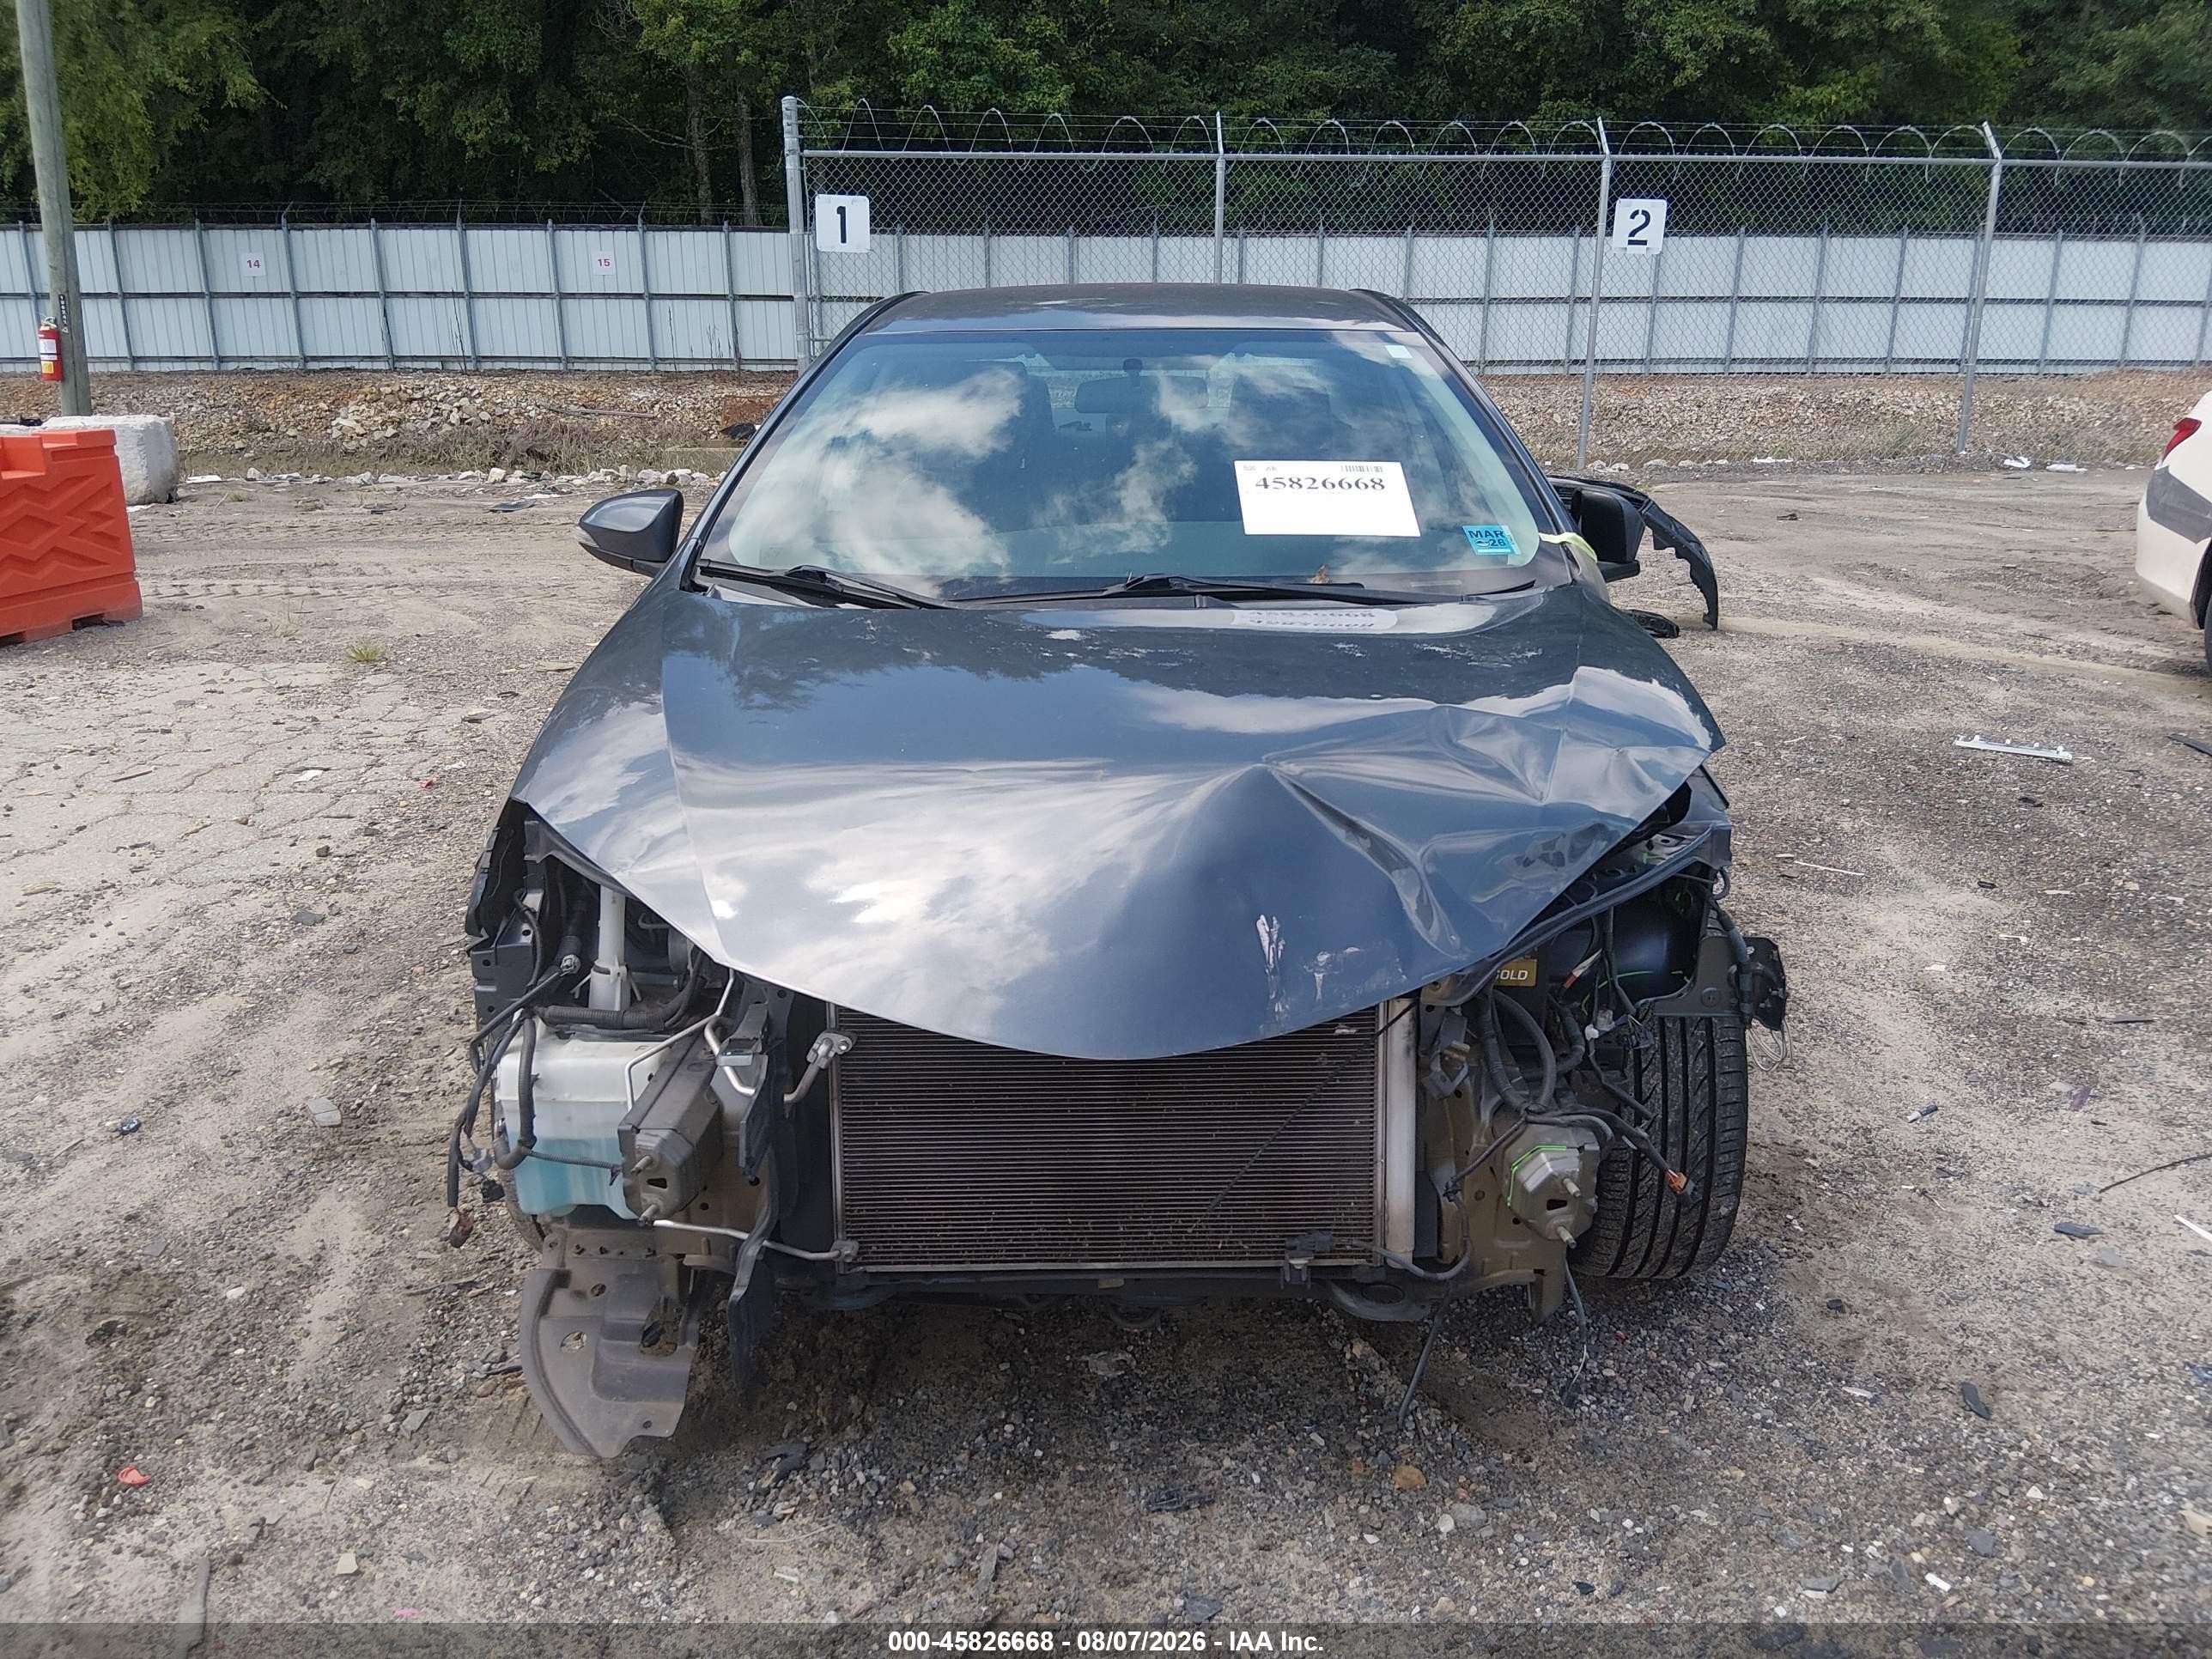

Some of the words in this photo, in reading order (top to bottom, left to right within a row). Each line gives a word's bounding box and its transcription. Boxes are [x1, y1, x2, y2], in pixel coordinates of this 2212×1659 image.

[836, 205, 847, 244] 1
[1627, 209, 1650, 246] 2
[246, 259, 261, 269] 14
[598, 258, 611, 267] 15
[1255, 477, 1386, 490] 45826668
[1468, 530, 1505, 538] MAR
